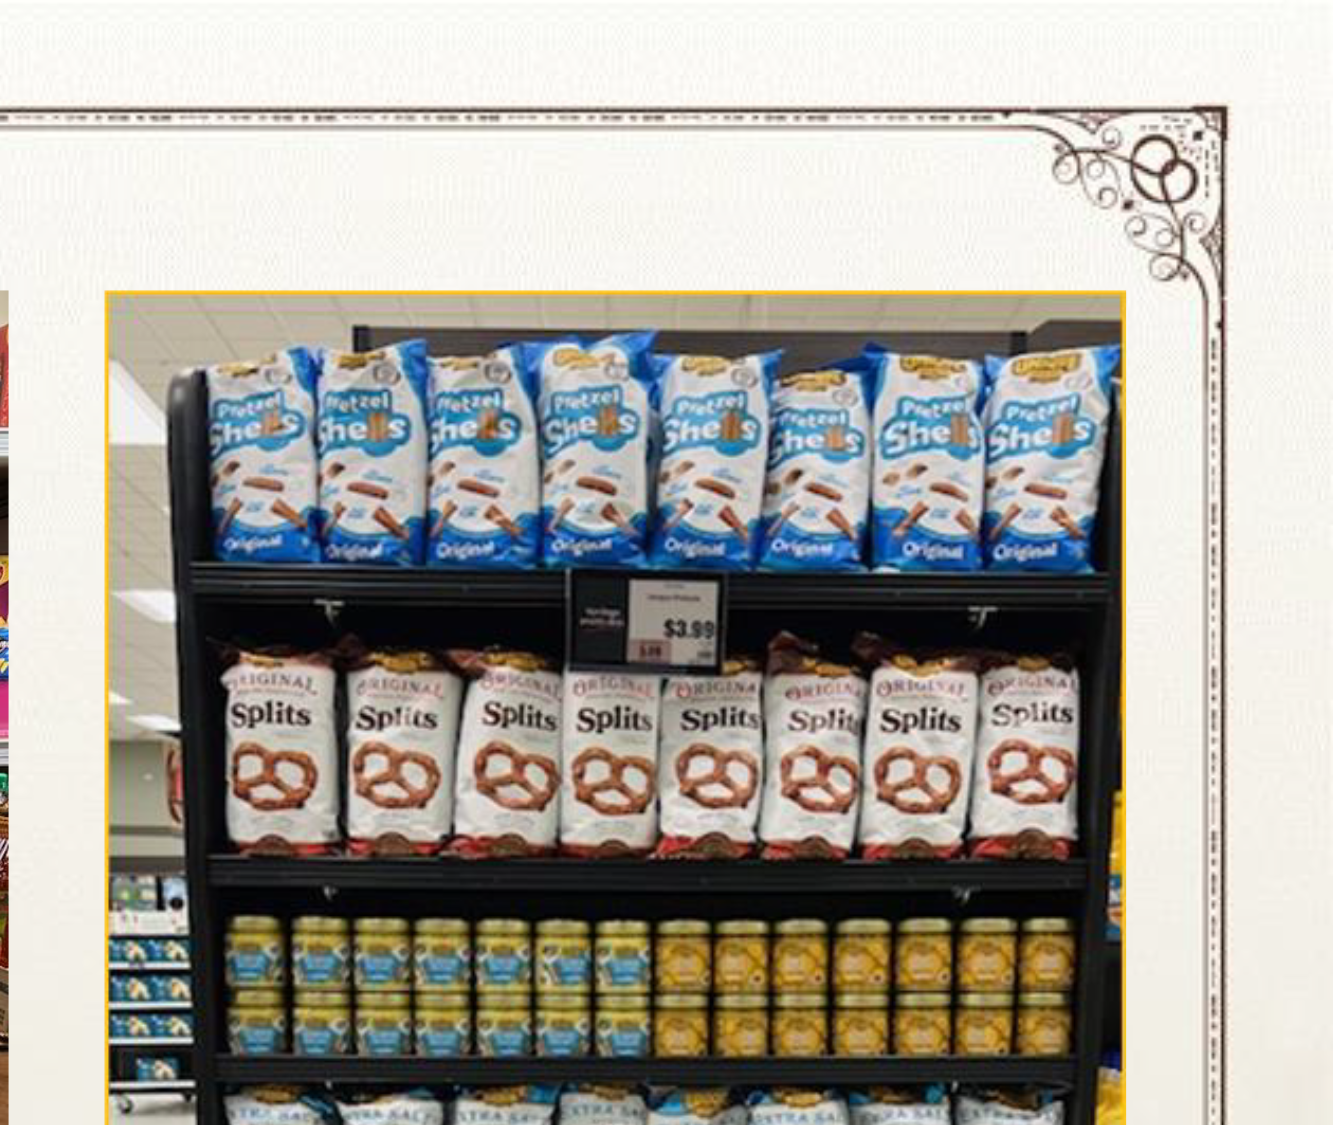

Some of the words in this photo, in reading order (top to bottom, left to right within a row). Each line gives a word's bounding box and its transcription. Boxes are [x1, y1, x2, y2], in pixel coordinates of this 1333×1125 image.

[218, 393, 282, 417] Pretzel
[325, 390, 390, 414] Pretzel
[437, 391, 501, 414] Pretzel
[555, 389, 621, 411] Pretzel
[677, 394, 745, 415] Pretzel
[903, 398, 966, 417] Pretzel
[1006, 396, 1078, 419] Pretzel
[781, 409, 847, 427] Pretzel
[224, 534, 283, 554] Original
[326, 542, 384, 561] Original
[437, 541, 495, 560] Original
[551, 538, 613, 554] Original
[664, 539, 725, 558] Original
[772, 539, 833, 558] Original
[903, 542, 964, 560] Original
[993, 542, 1057, 560] Original
[664, 619, 715, 639] $3.99
[356, 705, 438, 731] Splits
[483, 701, 558, 731] Splits
[680, 706, 761, 732] Splits
[991, 701, 1074, 729] Splits
